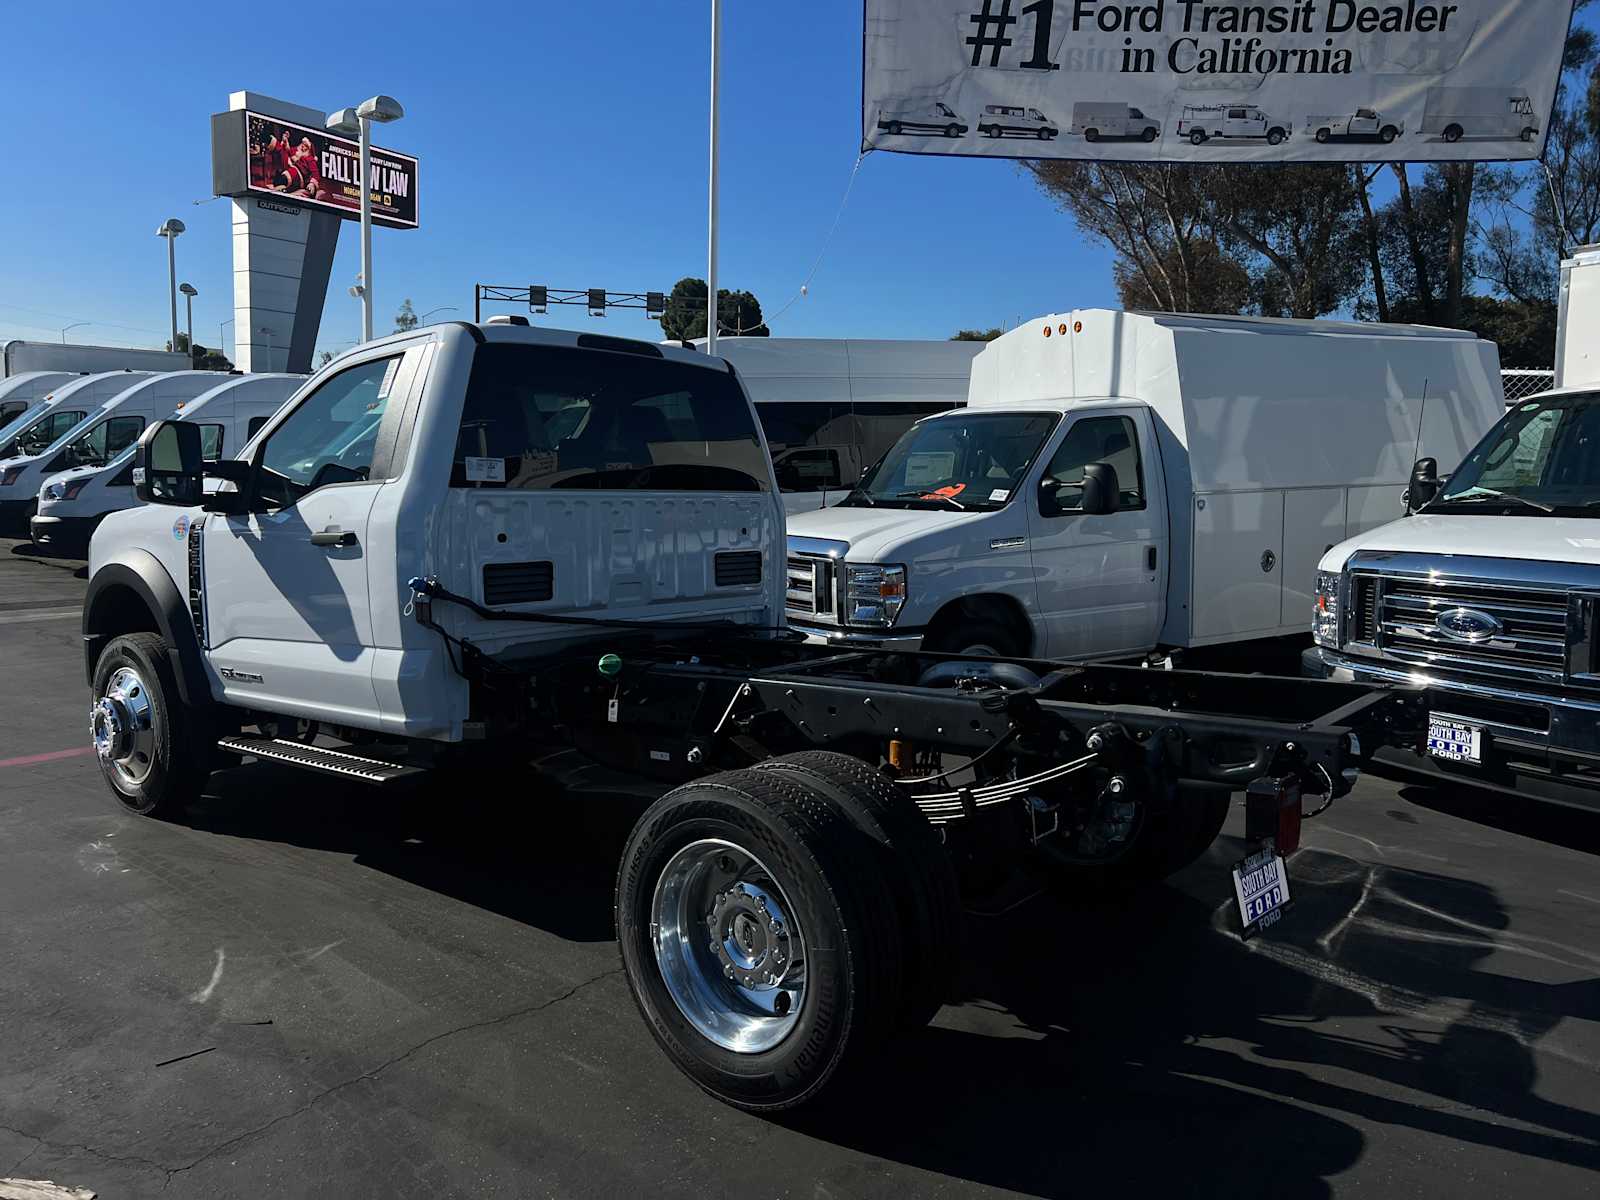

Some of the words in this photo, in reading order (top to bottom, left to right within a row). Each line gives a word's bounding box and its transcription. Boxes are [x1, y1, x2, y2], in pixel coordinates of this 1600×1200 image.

[1072, 0, 1165, 32] Ford
[1176, 0, 1316, 33] Transit
[1326, 0, 1458, 33] Dealer
[966, 0, 1060, 70] #1
[1119, 37, 1155, 73] in
[1167, 37, 1353, 74] California
[321, 151, 351, 184] FALL
[382, 168, 409, 198] LAW
[1427, 738, 1471, 754] FORD
[1428, 726, 1452, 739] OUTH
[1455, 731, 1471, 744] BAY
[1241, 867, 1265, 897] SOUTH
[1263, 860, 1278, 884] BAY
[1246, 887, 1281, 920] FORD
[1258, 908, 1282, 931] FORD
